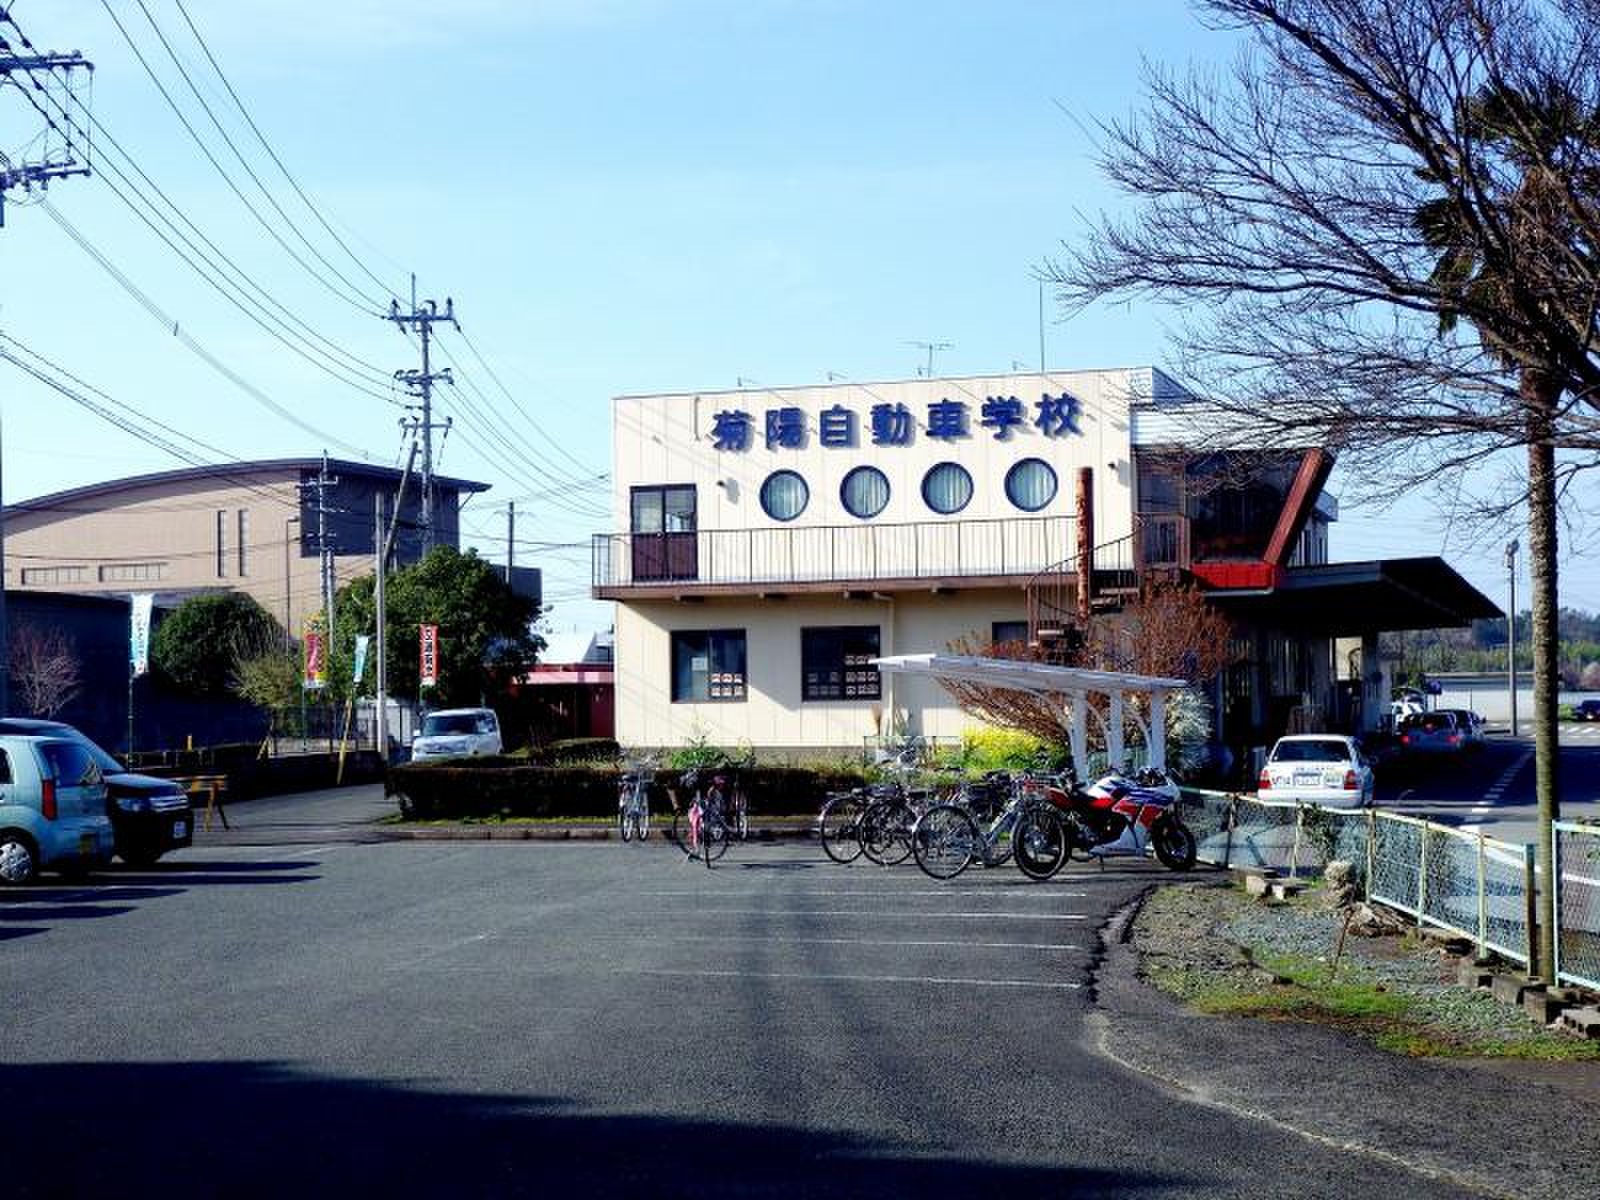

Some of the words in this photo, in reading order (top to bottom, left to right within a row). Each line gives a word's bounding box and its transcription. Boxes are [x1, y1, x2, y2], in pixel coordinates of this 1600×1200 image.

[711, 392, 1082, 451] 菊陽自動車学校
